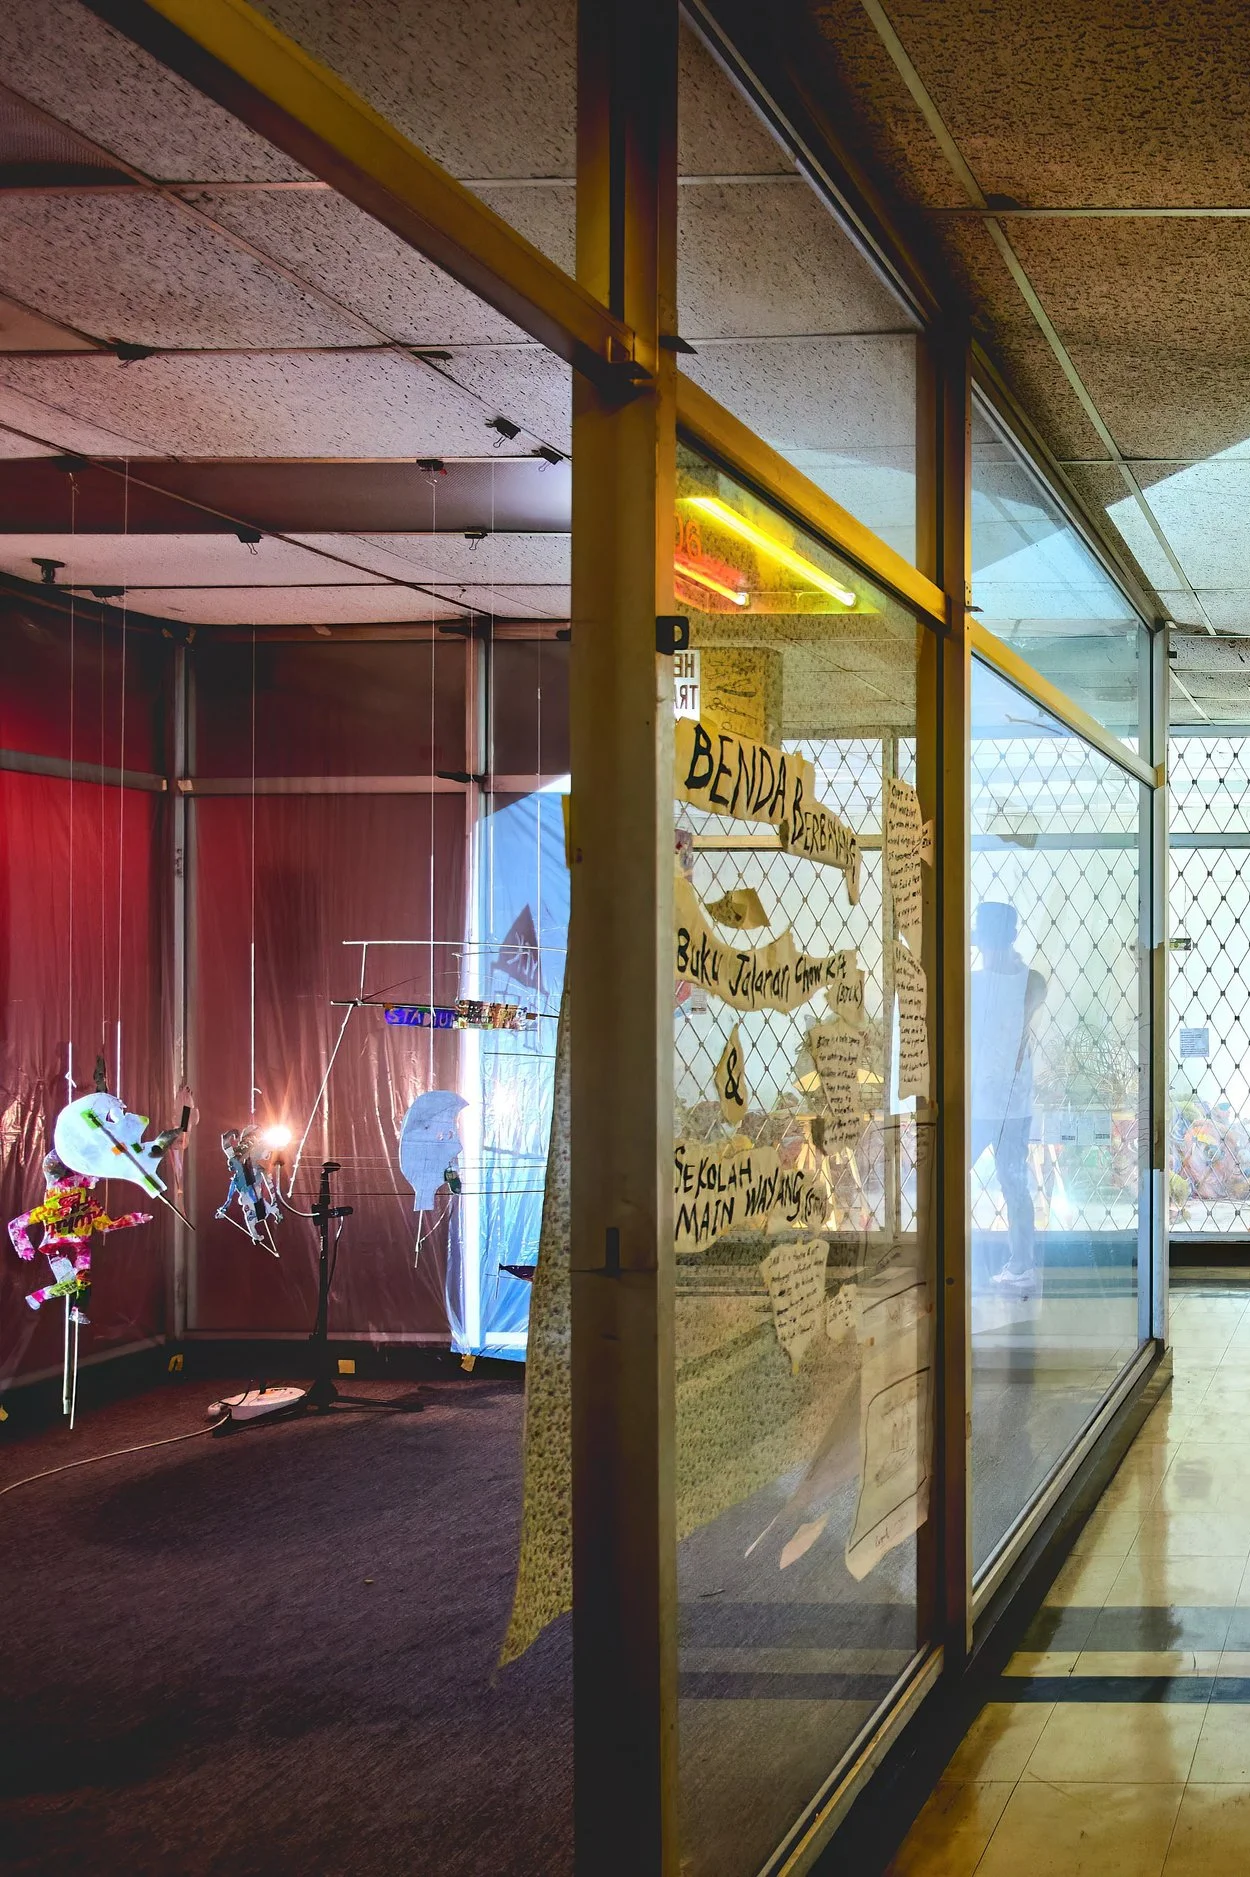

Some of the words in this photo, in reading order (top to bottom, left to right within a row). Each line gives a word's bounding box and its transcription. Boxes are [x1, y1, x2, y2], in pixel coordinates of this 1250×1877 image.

[684, 723, 786, 820] BENDA
[677, 928, 723, 985] Buku
[730, 953, 791, 1009] Jalanan
[794, 955, 823, 992] Chow
[825, 949, 848, 985] Kit
[725, 1051, 744, 1106] &
[674, 1145, 753, 1199] SEKOLAH
[675, 1197, 736, 1244] MAIN
[745, 1167, 804, 1223] WAYANG
